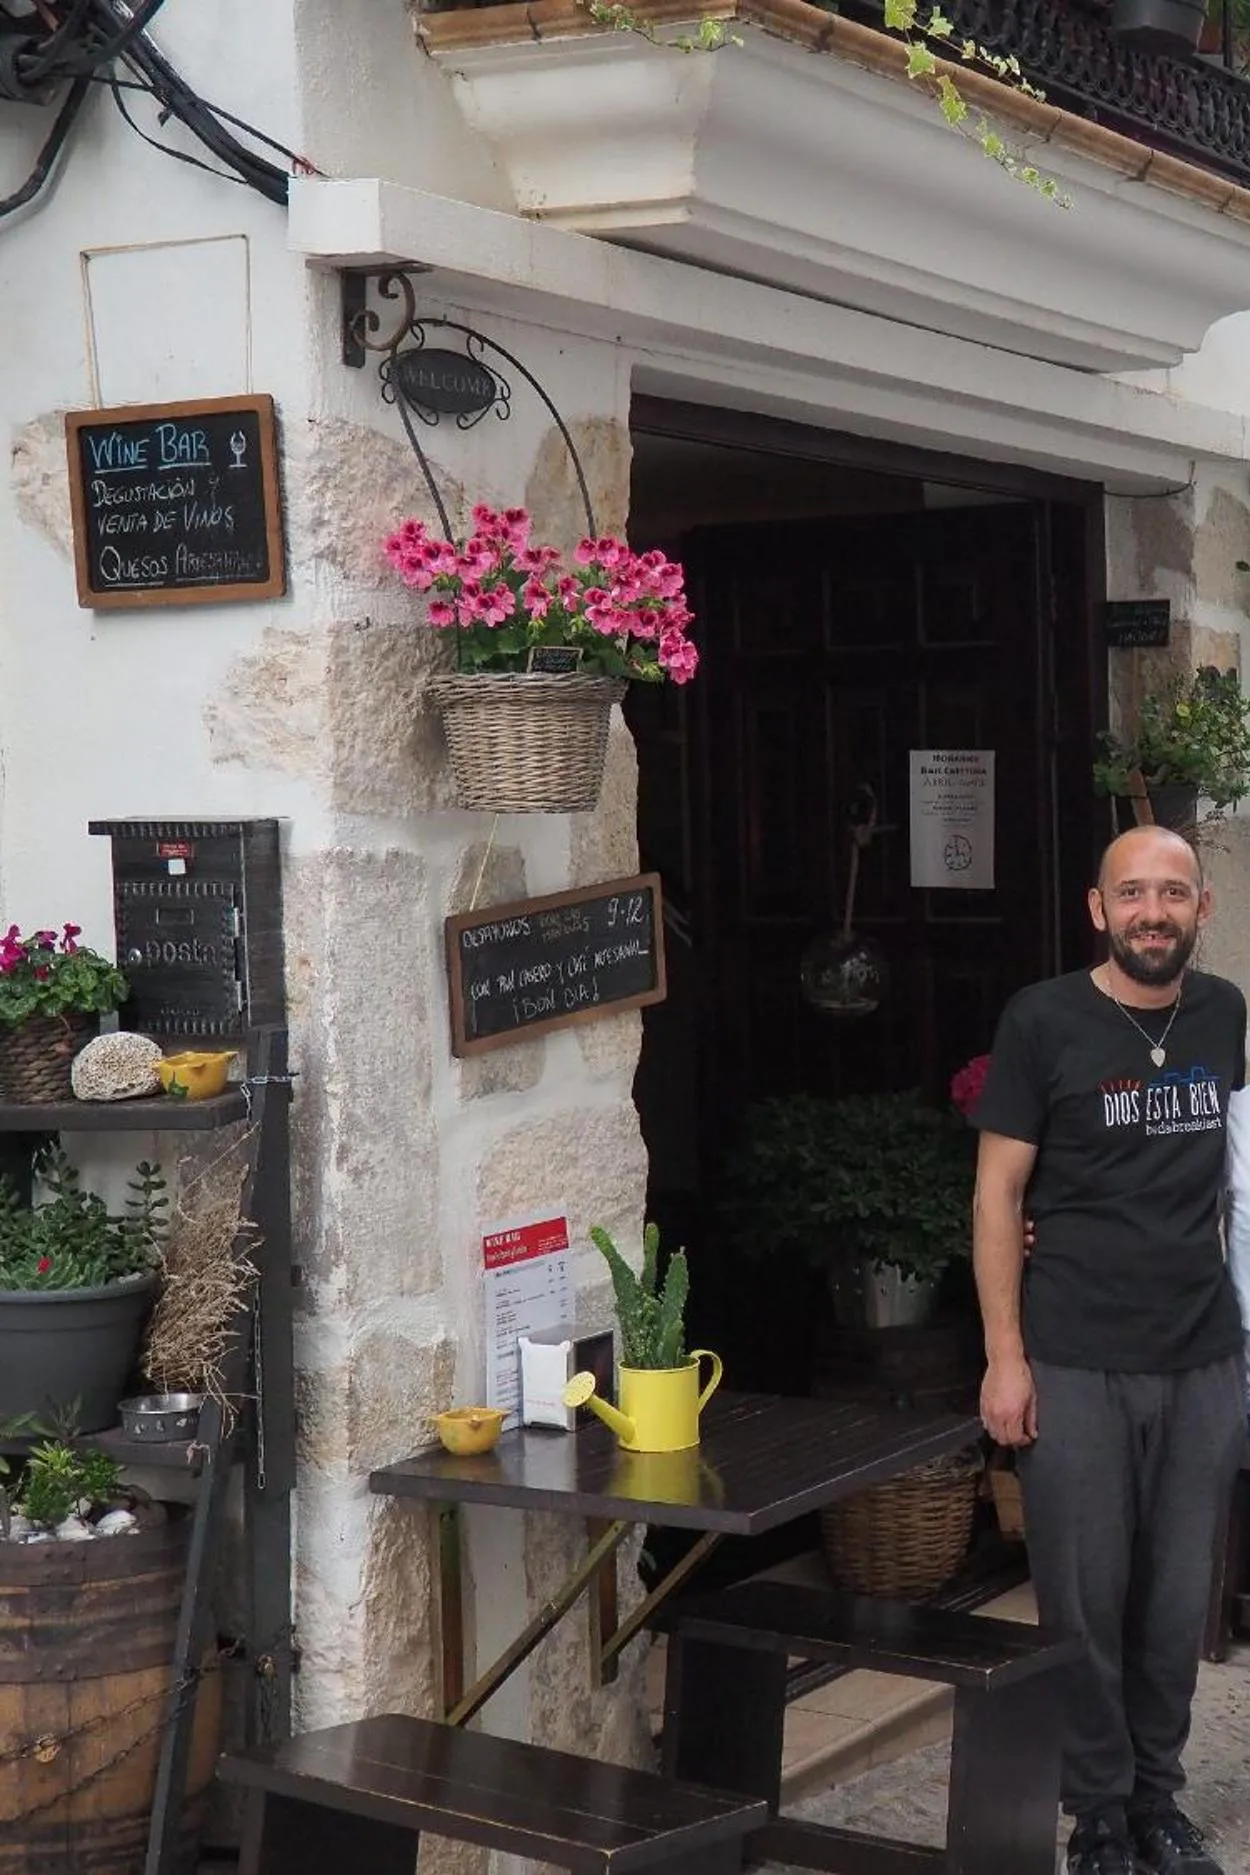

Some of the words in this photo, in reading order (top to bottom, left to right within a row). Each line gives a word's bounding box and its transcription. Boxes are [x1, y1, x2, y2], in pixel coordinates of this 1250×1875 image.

[155, 423, 212, 463] BAR
[153, 511, 177, 532] DE
[100, 545, 169, 581] QUESOS
[1104, 1090, 1140, 1127] DIOS
[1146, 1085, 1182, 1121] ESTA
[1189, 1080, 1221, 1116] BIEN
